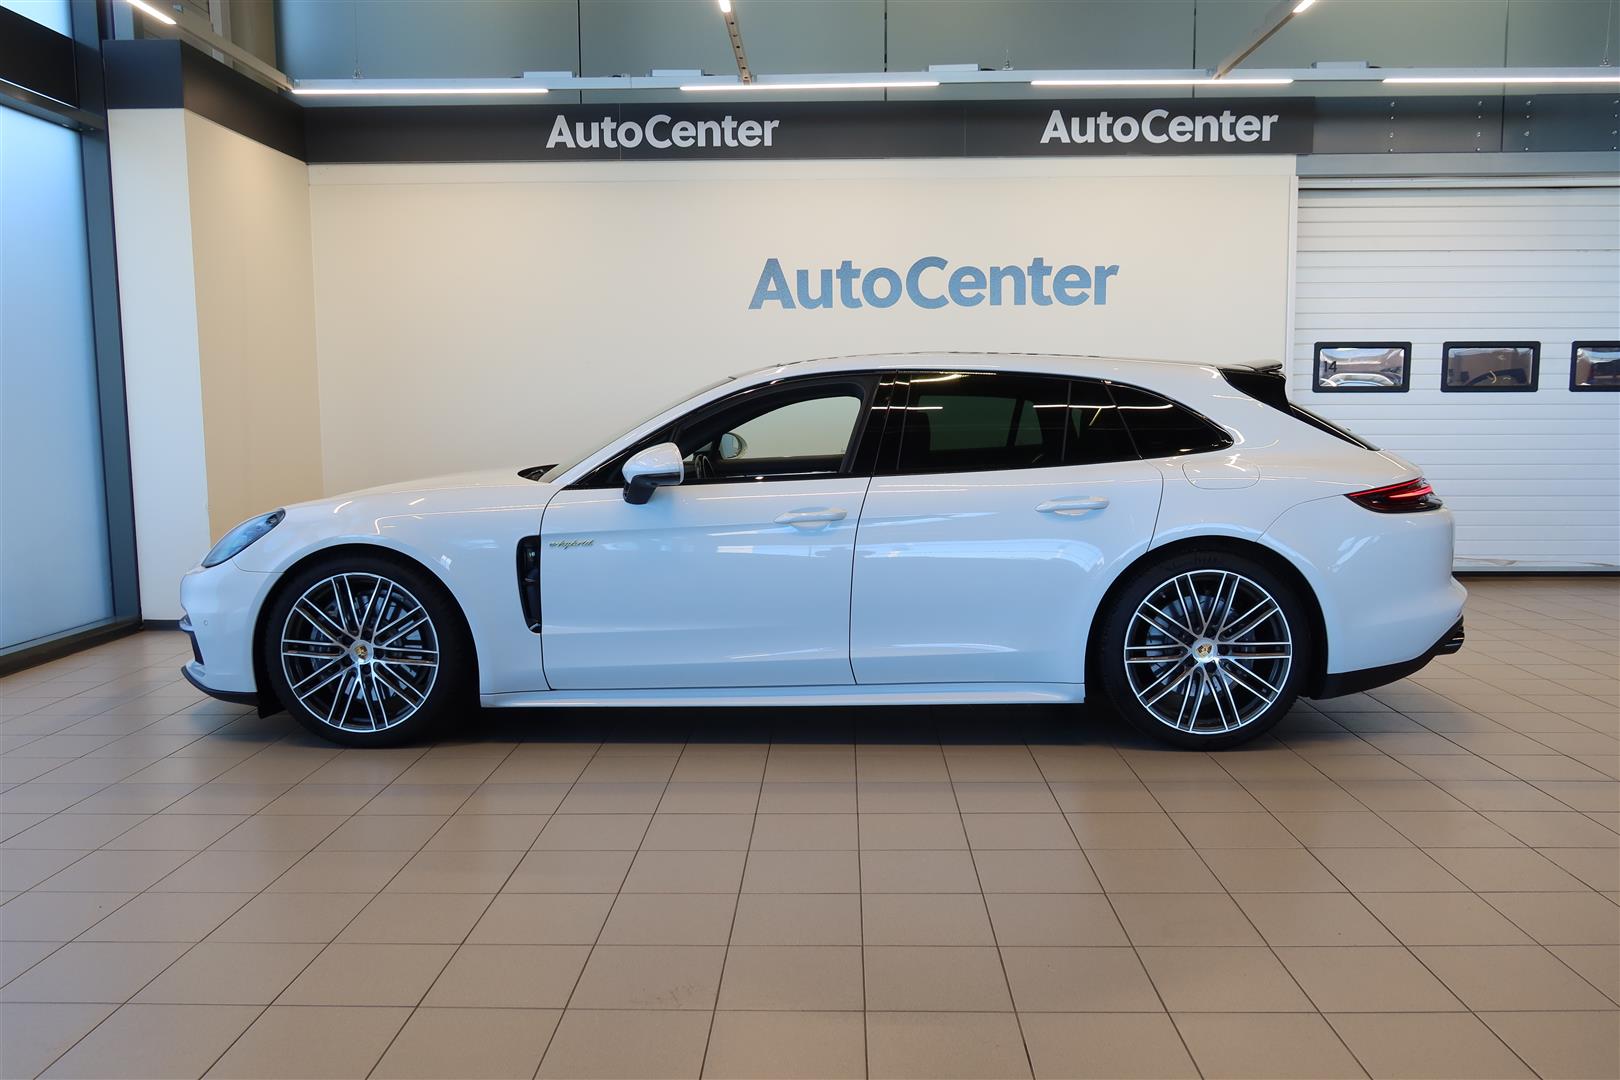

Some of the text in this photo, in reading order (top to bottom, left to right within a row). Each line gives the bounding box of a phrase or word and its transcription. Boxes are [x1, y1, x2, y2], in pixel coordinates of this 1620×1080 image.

[546, 114, 780, 149] AutoCenter
[1040, 108, 1279, 143] AutoCenter
[748, 255, 1120, 311] AutoCenter
[1324, 360, 1337, 373] 14
